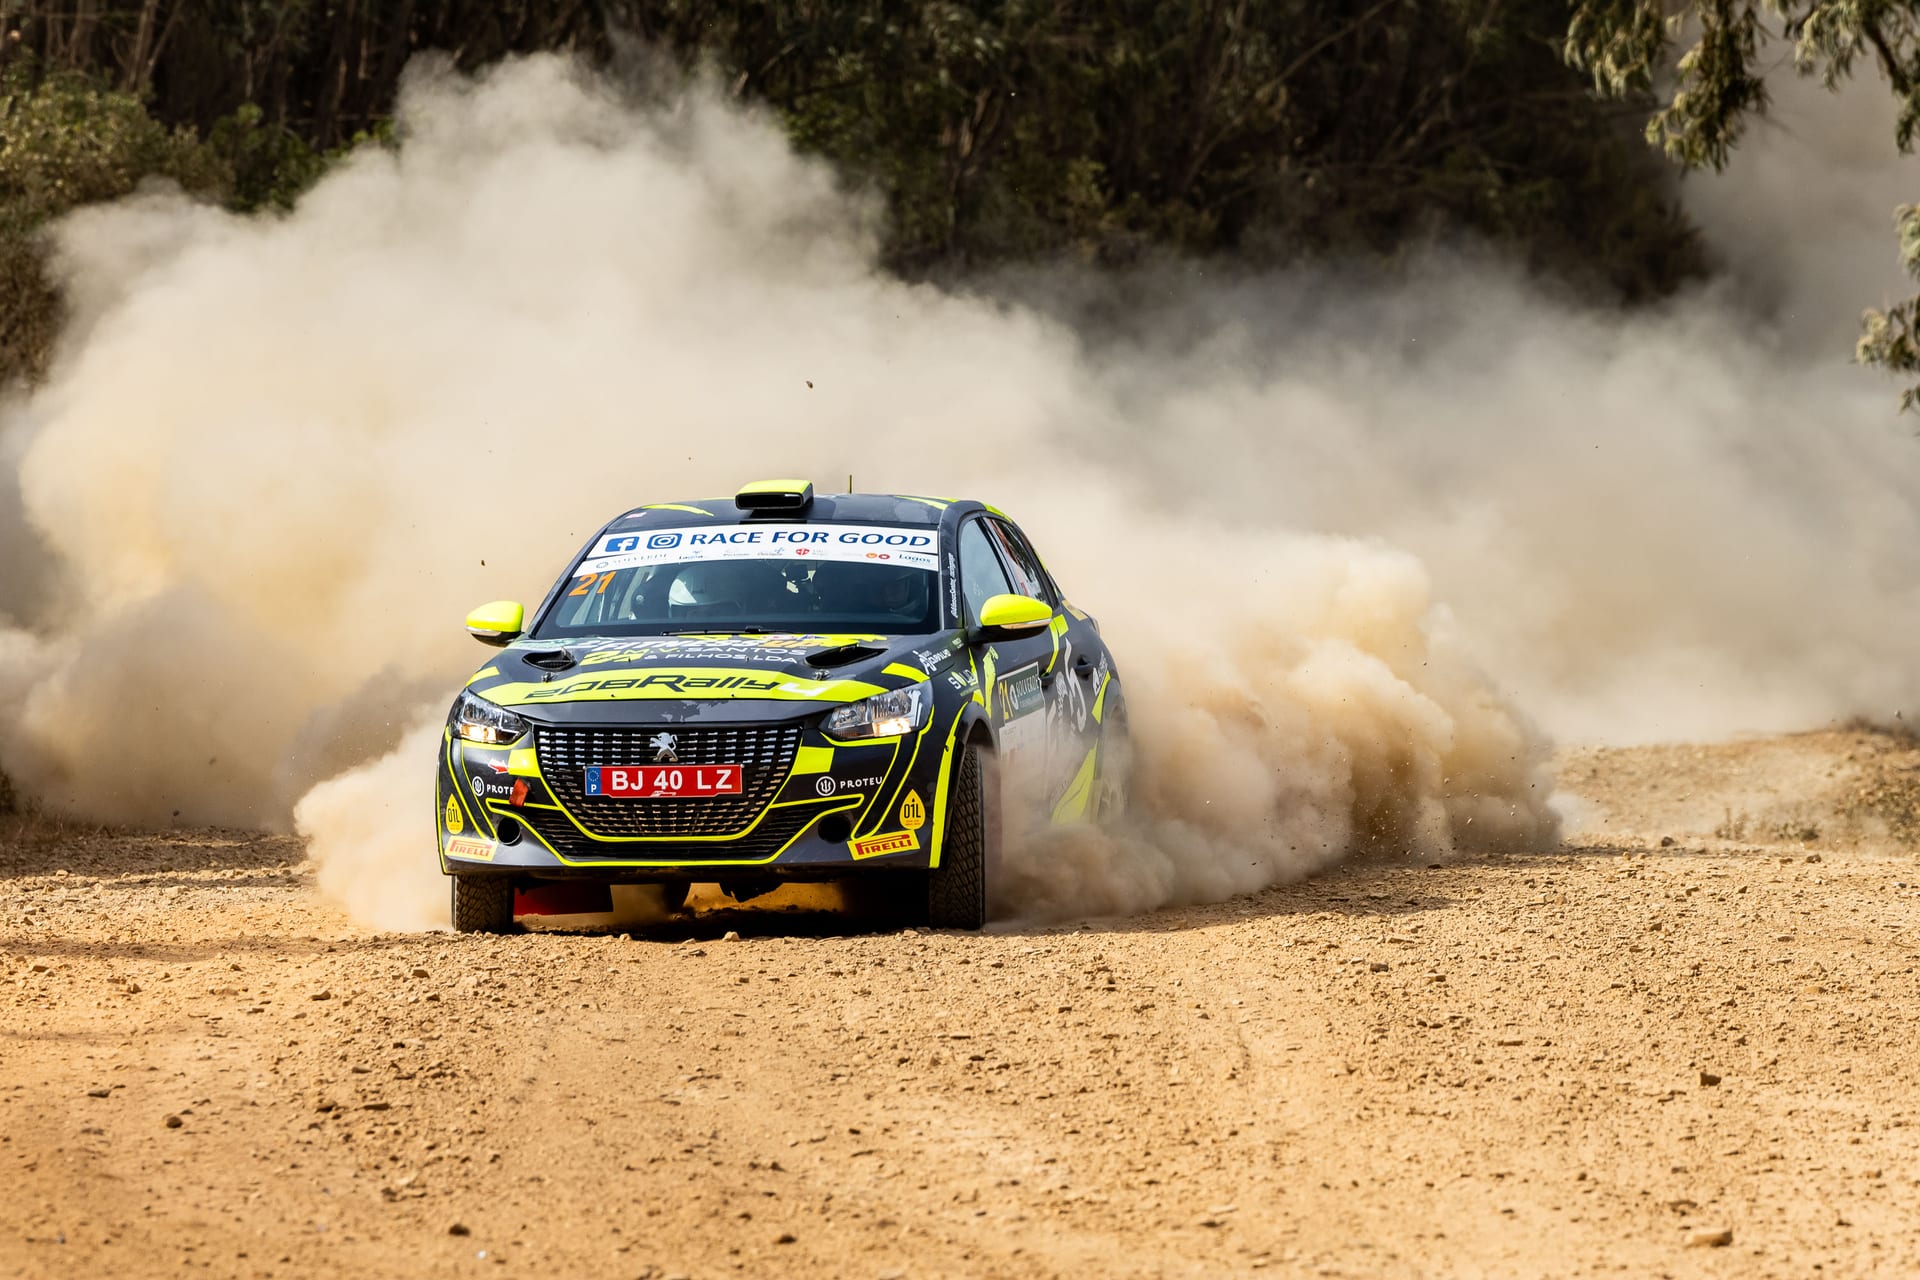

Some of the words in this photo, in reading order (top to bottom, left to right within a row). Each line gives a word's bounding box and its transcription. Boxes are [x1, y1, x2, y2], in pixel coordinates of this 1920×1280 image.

[690, 531, 763, 545] RACE
[772, 531, 829, 543] FOR
[838, 532, 931, 546] GOOD
[568, 571, 616, 596] 21
[999, 680, 1014, 720] 21
[611, 771, 643, 790] BJ
[653, 770, 683, 790] 40
[697, 769, 732, 790] LZ
[449, 839, 493, 857] PIRELLI
[854, 834, 912, 855] PIRELLI
